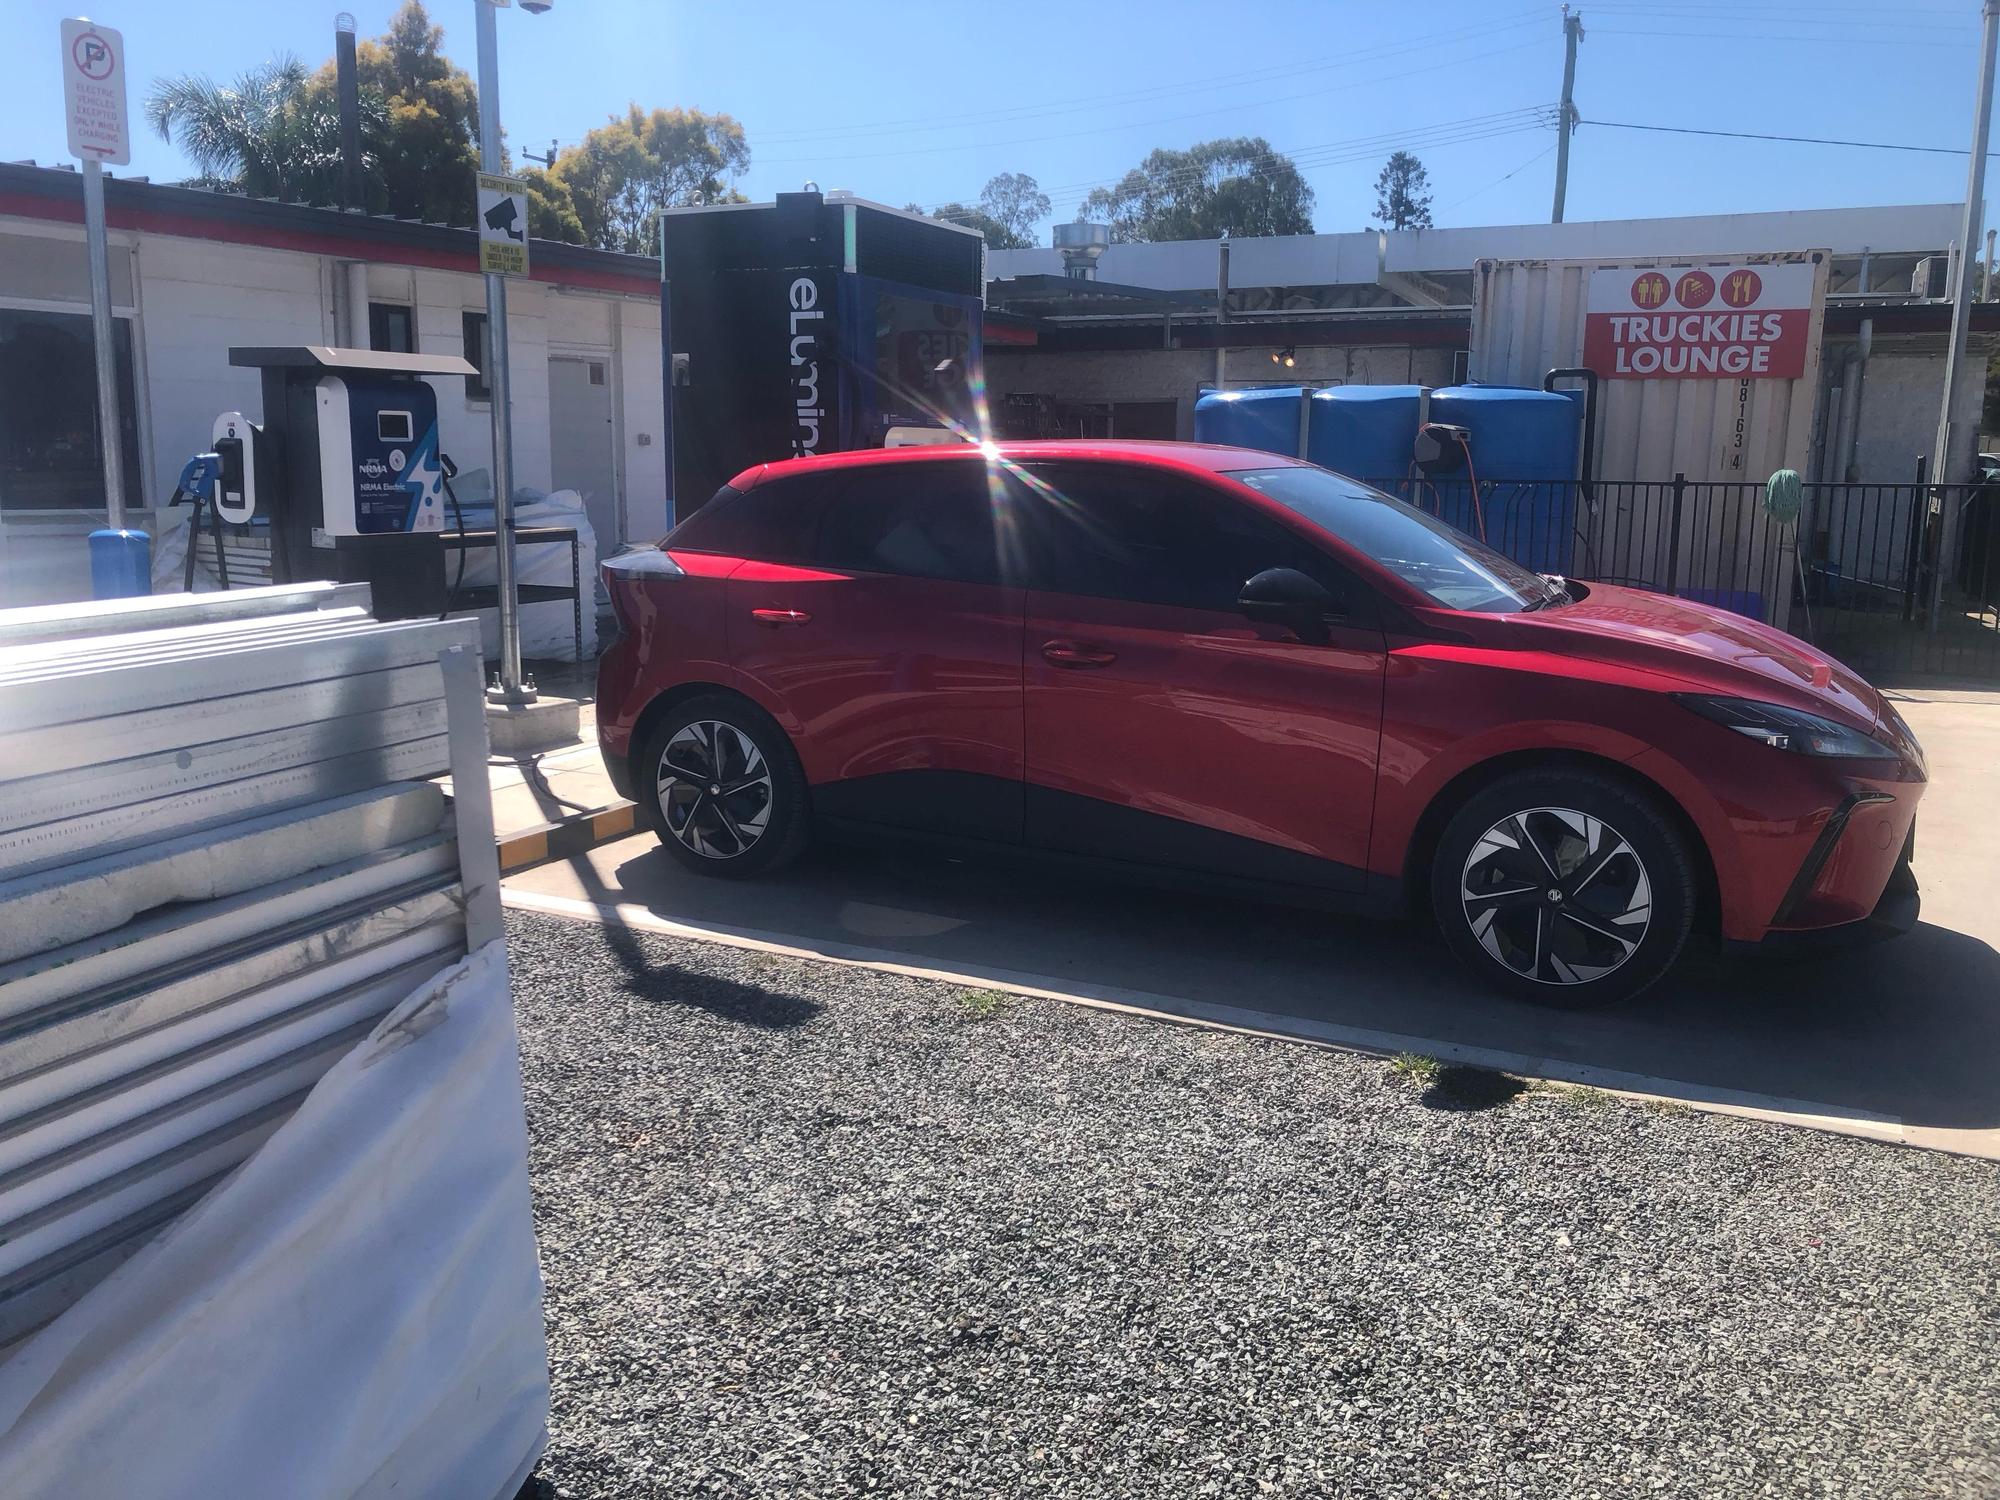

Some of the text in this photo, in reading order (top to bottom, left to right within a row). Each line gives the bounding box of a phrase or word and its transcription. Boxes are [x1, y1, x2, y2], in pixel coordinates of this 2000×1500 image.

[76, 82, 115, 97] ELECTRIC
[78, 95, 116, 109] VEHICLES
[76, 105, 117, 120] EXCEPTED
[73, 115, 120, 133] ONLY WHILE
[78, 128, 119, 143] CHARGING
[1609, 313, 1782, 343] TRUCKIES
[1615, 345, 1770, 374] LOUNGE
[359, 465, 387, 473] NRMA
[360, 483, 406, 491] NRMA Electric
